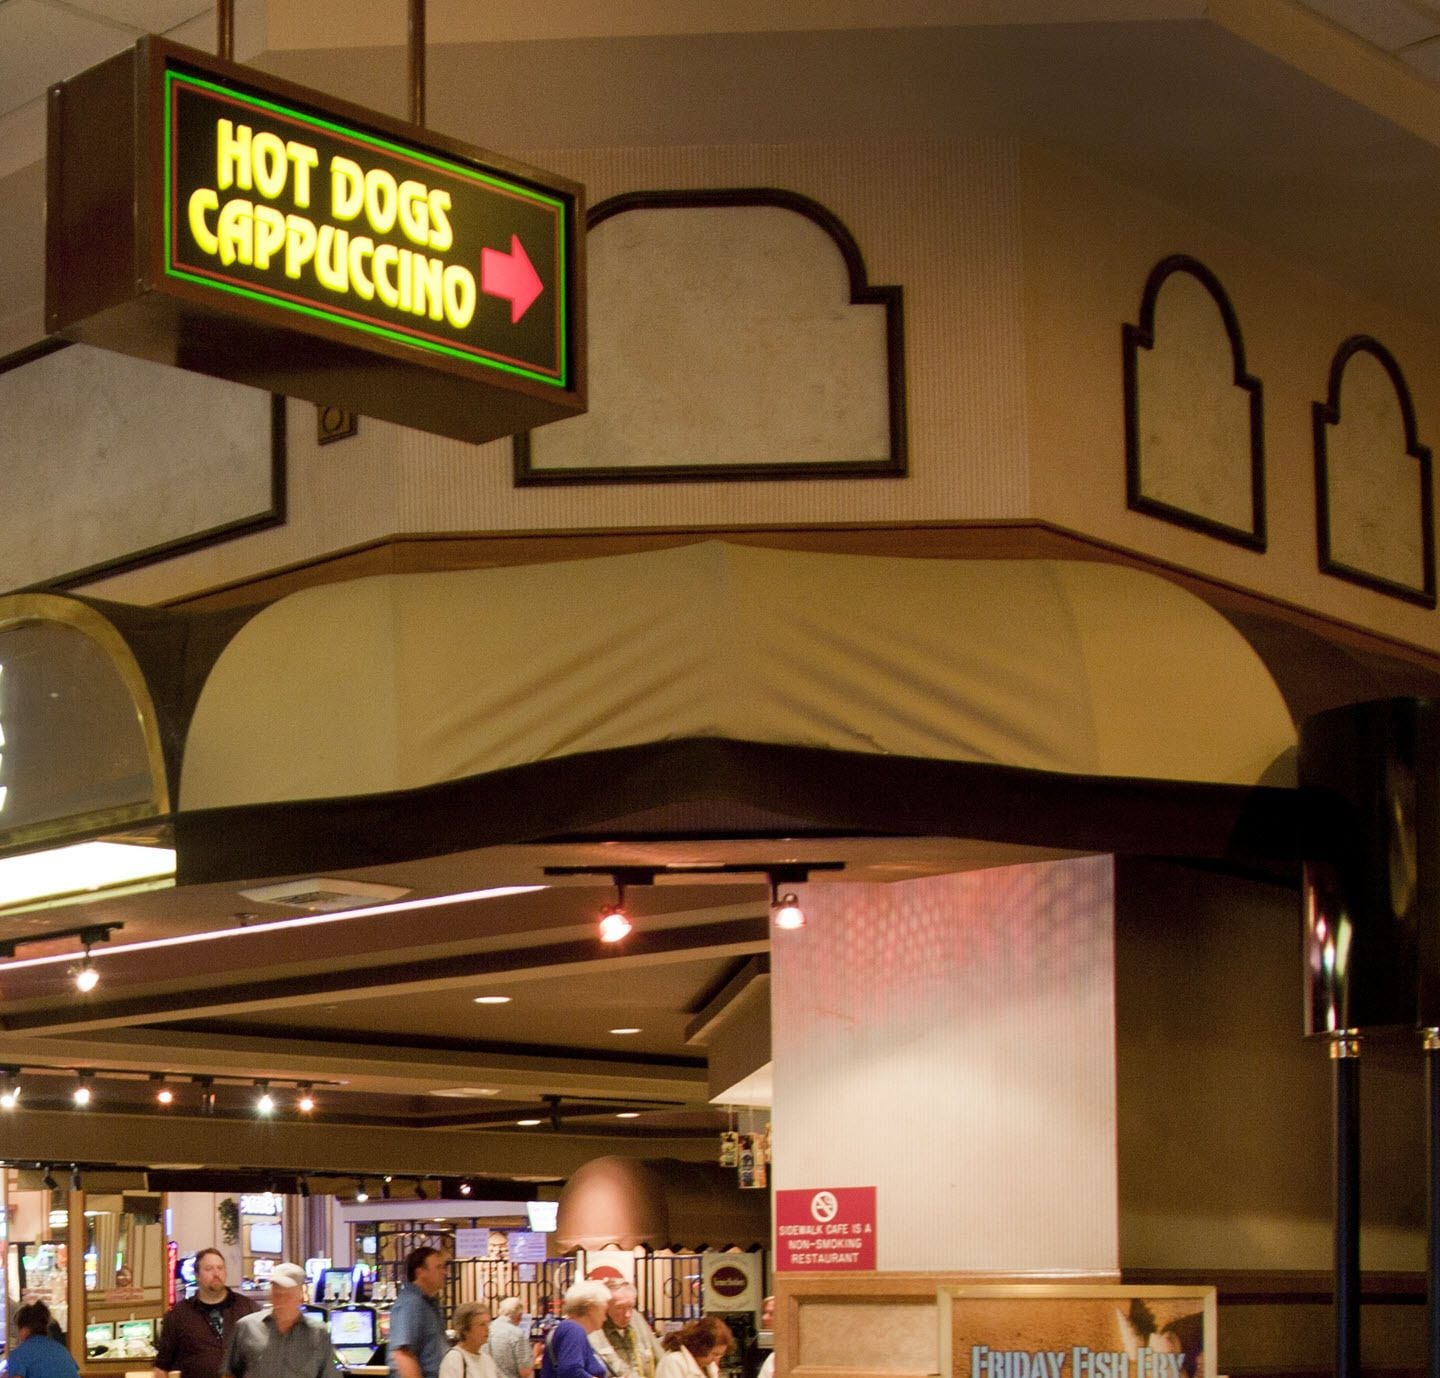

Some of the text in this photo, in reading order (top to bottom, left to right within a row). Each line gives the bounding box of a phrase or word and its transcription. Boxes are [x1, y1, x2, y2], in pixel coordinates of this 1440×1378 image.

[216, 118, 454, 252] HOT DOGS
[188, 188, 477, 329] CAPPUCCINO
[779, 1223, 872, 1236] SIDEWALK CAFE IS A
[788, 1238, 863, 1250] NON-SMOKING
[791, 1252, 860, 1264] RESTAURANT
